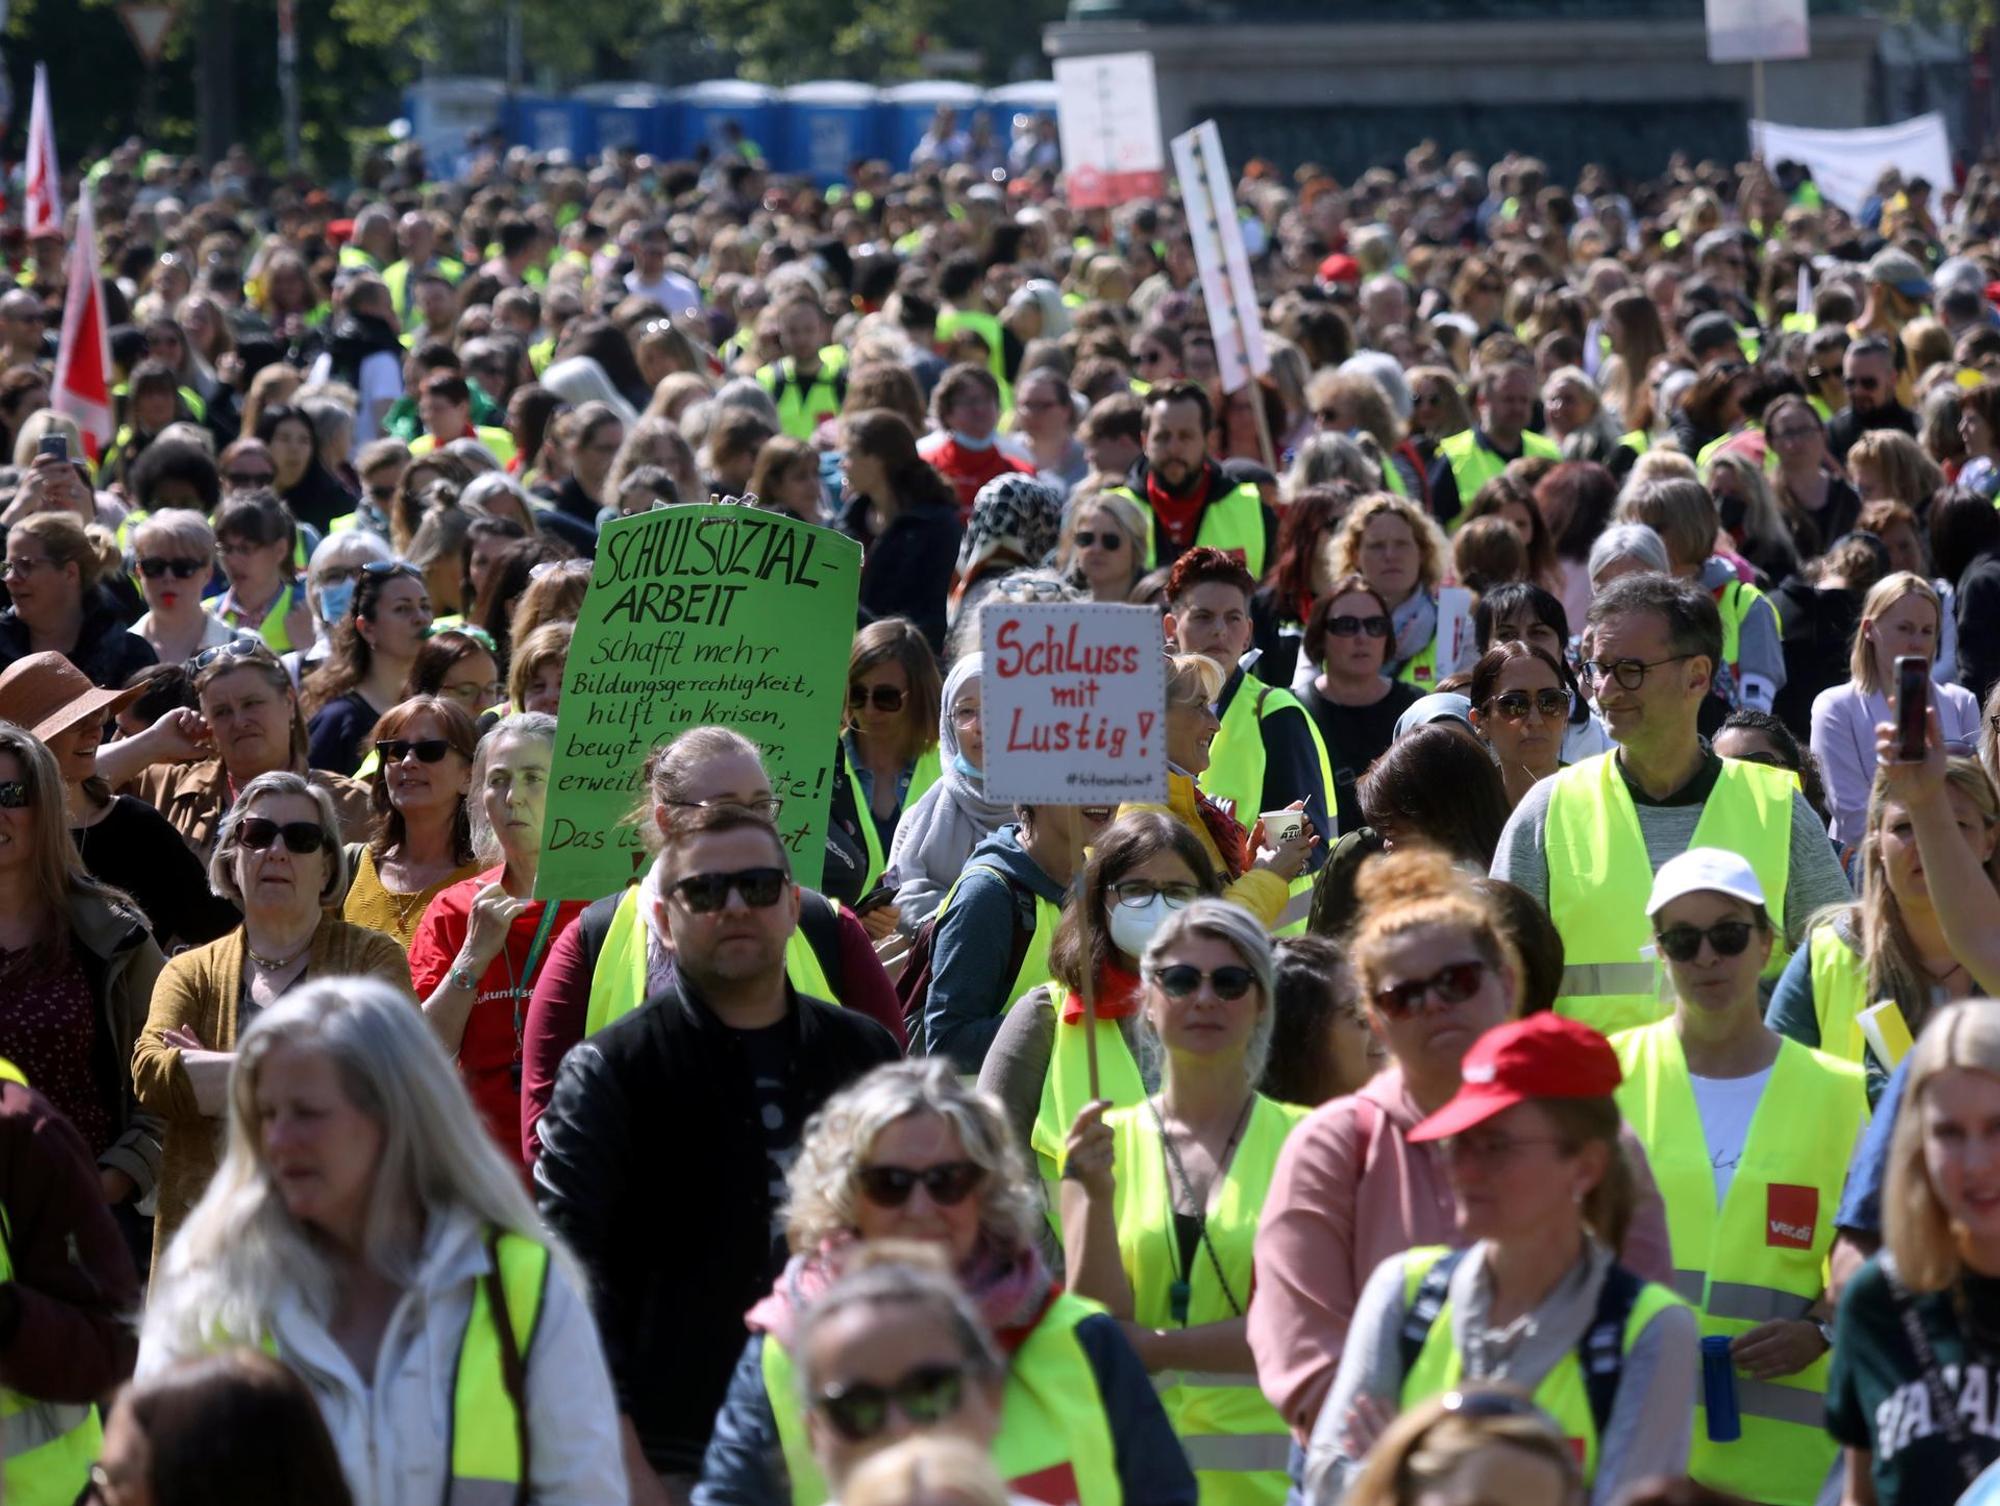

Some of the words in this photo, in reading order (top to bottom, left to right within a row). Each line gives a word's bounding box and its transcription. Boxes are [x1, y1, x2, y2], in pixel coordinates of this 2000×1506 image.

[595, 516, 839, 589] SCHULSOZIAL-
[602, 582, 748, 626] ARBEIT
[693, 634, 779, 664] mehr
[1050, 679, 1100, 707] mit
[587, 702, 654, 733] hilft
[669, 704, 692, 723] in
[700, 703, 787, 729] Krisen,
[565, 733, 642, 768] beugt
[549, 818, 605, 850] Das
[618, 828, 641, 847] is
